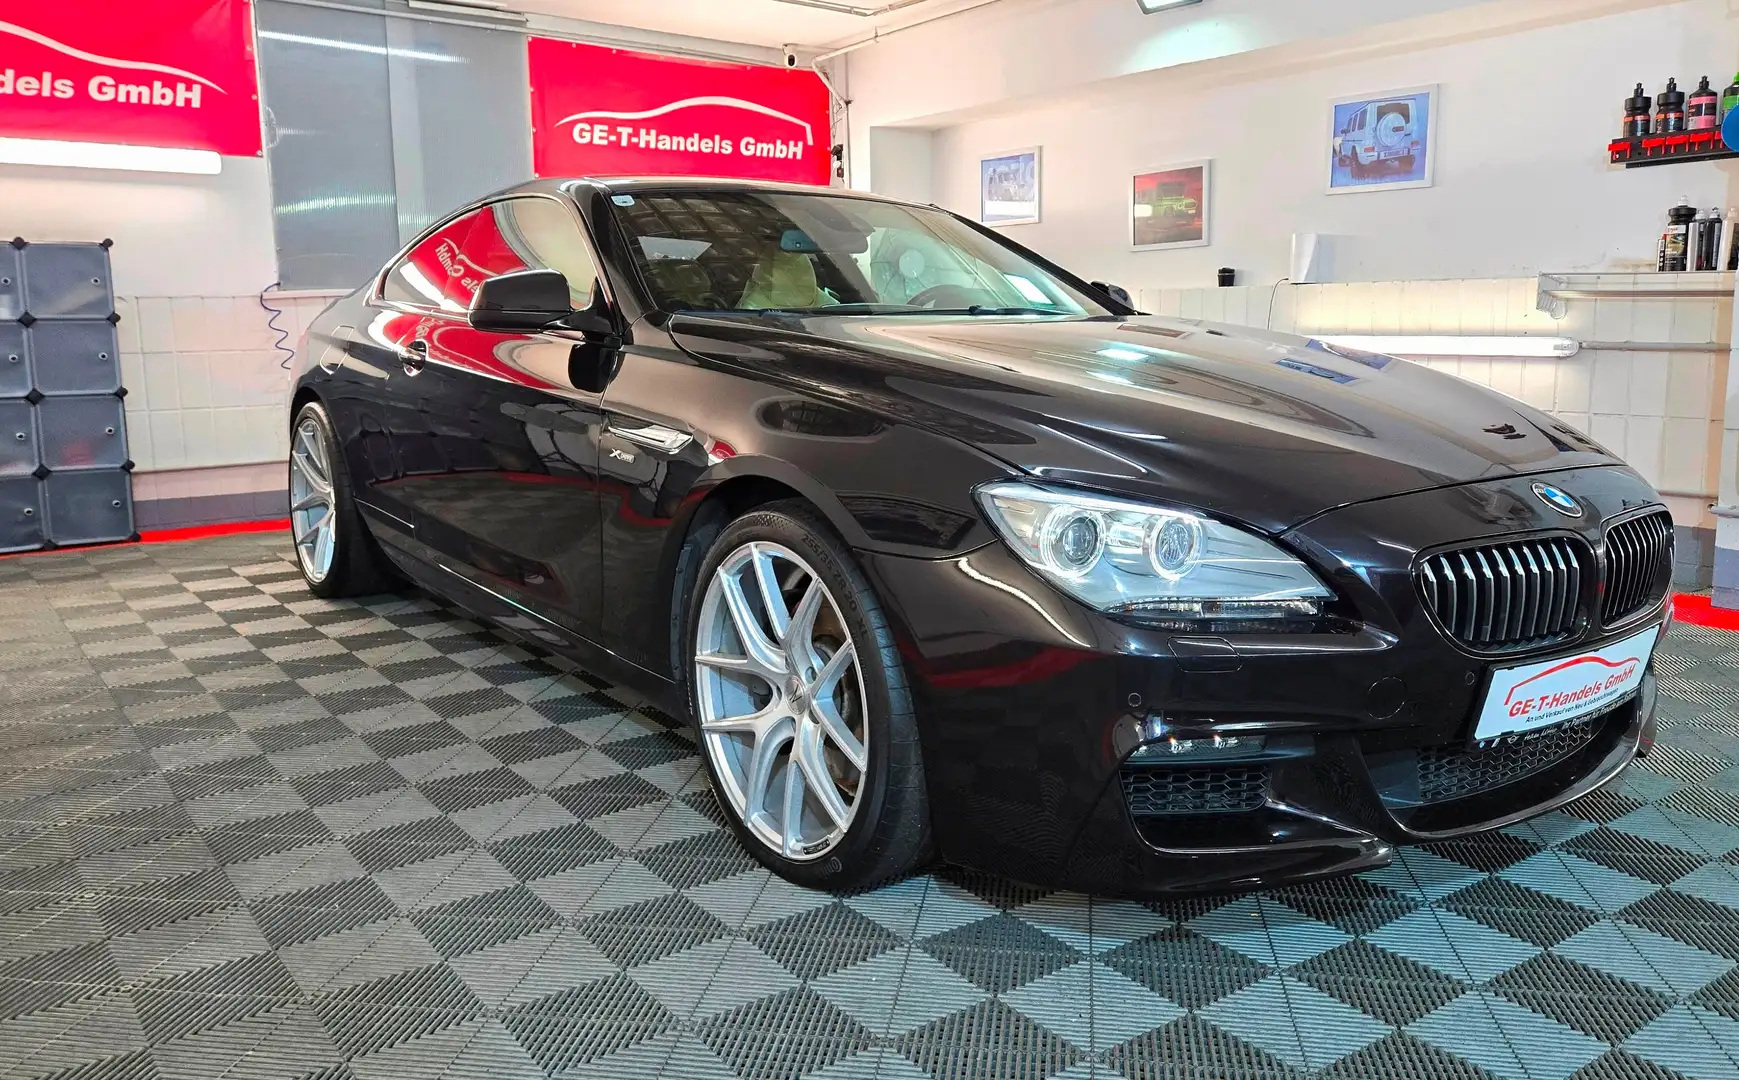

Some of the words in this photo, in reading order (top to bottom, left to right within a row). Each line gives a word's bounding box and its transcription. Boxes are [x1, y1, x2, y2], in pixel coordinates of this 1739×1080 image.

[88, 75, 202, 108] GmbH
[572, 122, 733, 155] GE-T-Handels
[739, 136, 804, 160] GmbH
[1508, 680, 1602, 717] GE-T-Handels
[1604, 663, 1636, 690] GmbH
